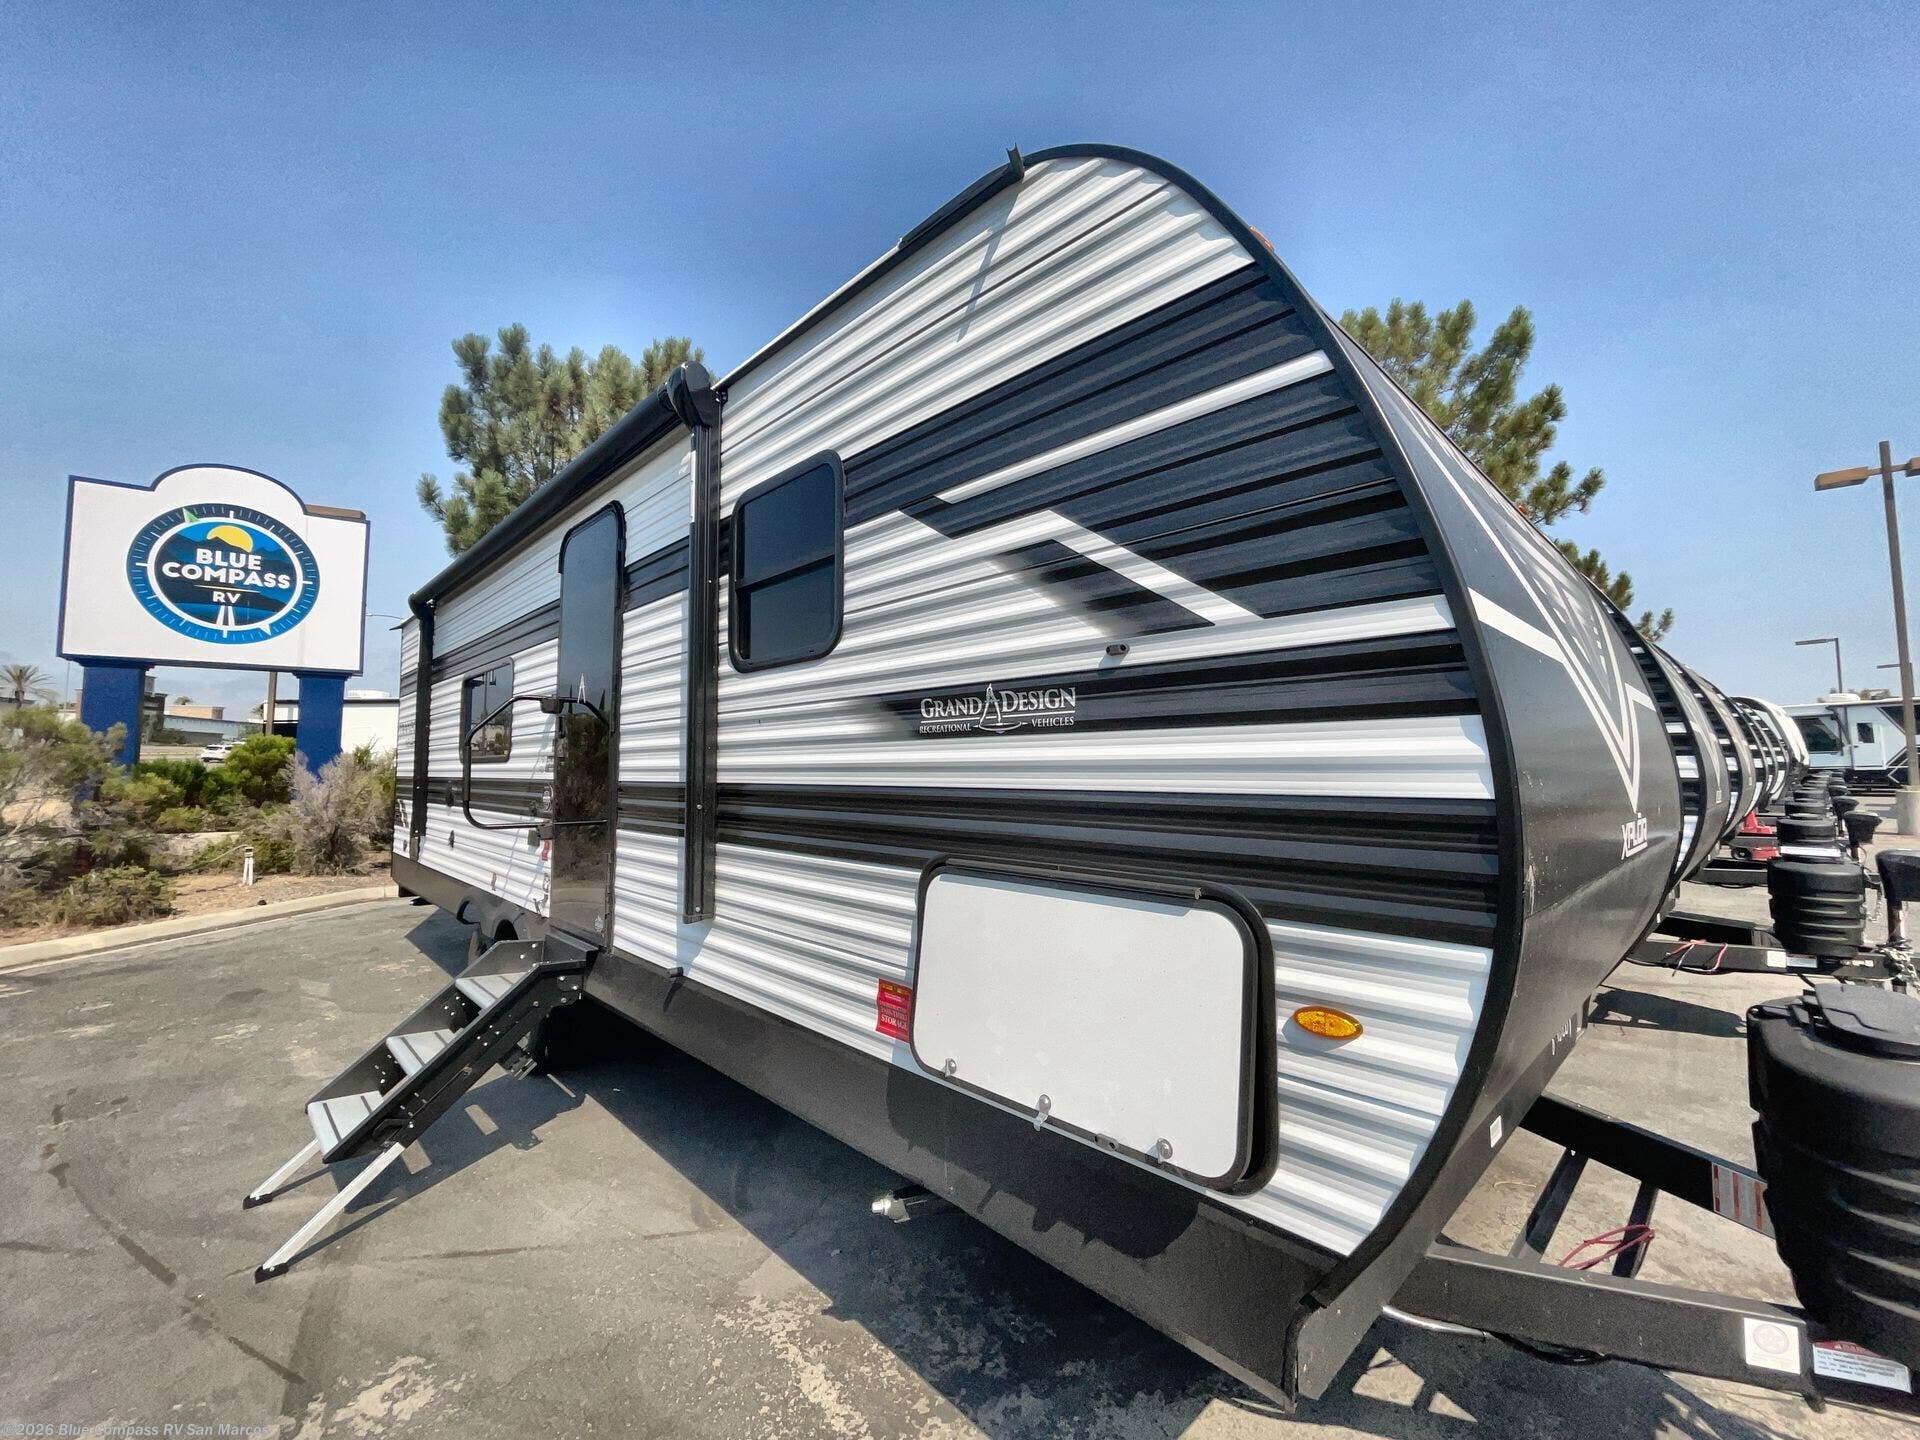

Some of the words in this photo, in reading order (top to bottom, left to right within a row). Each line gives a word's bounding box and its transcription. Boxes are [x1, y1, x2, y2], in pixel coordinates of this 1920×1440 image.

[196, 548, 262, 570] BLUE
[162, 562, 291, 589] COMPASS
[212, 591, 241, 604] RV
[920, 698, 982, 719] GRAND
[999, 687, 1076, 713] DESIGN
[919, 723, 972, 734] RECREATIONAL
[1031, 716, 1075, 728] VEHICLES
